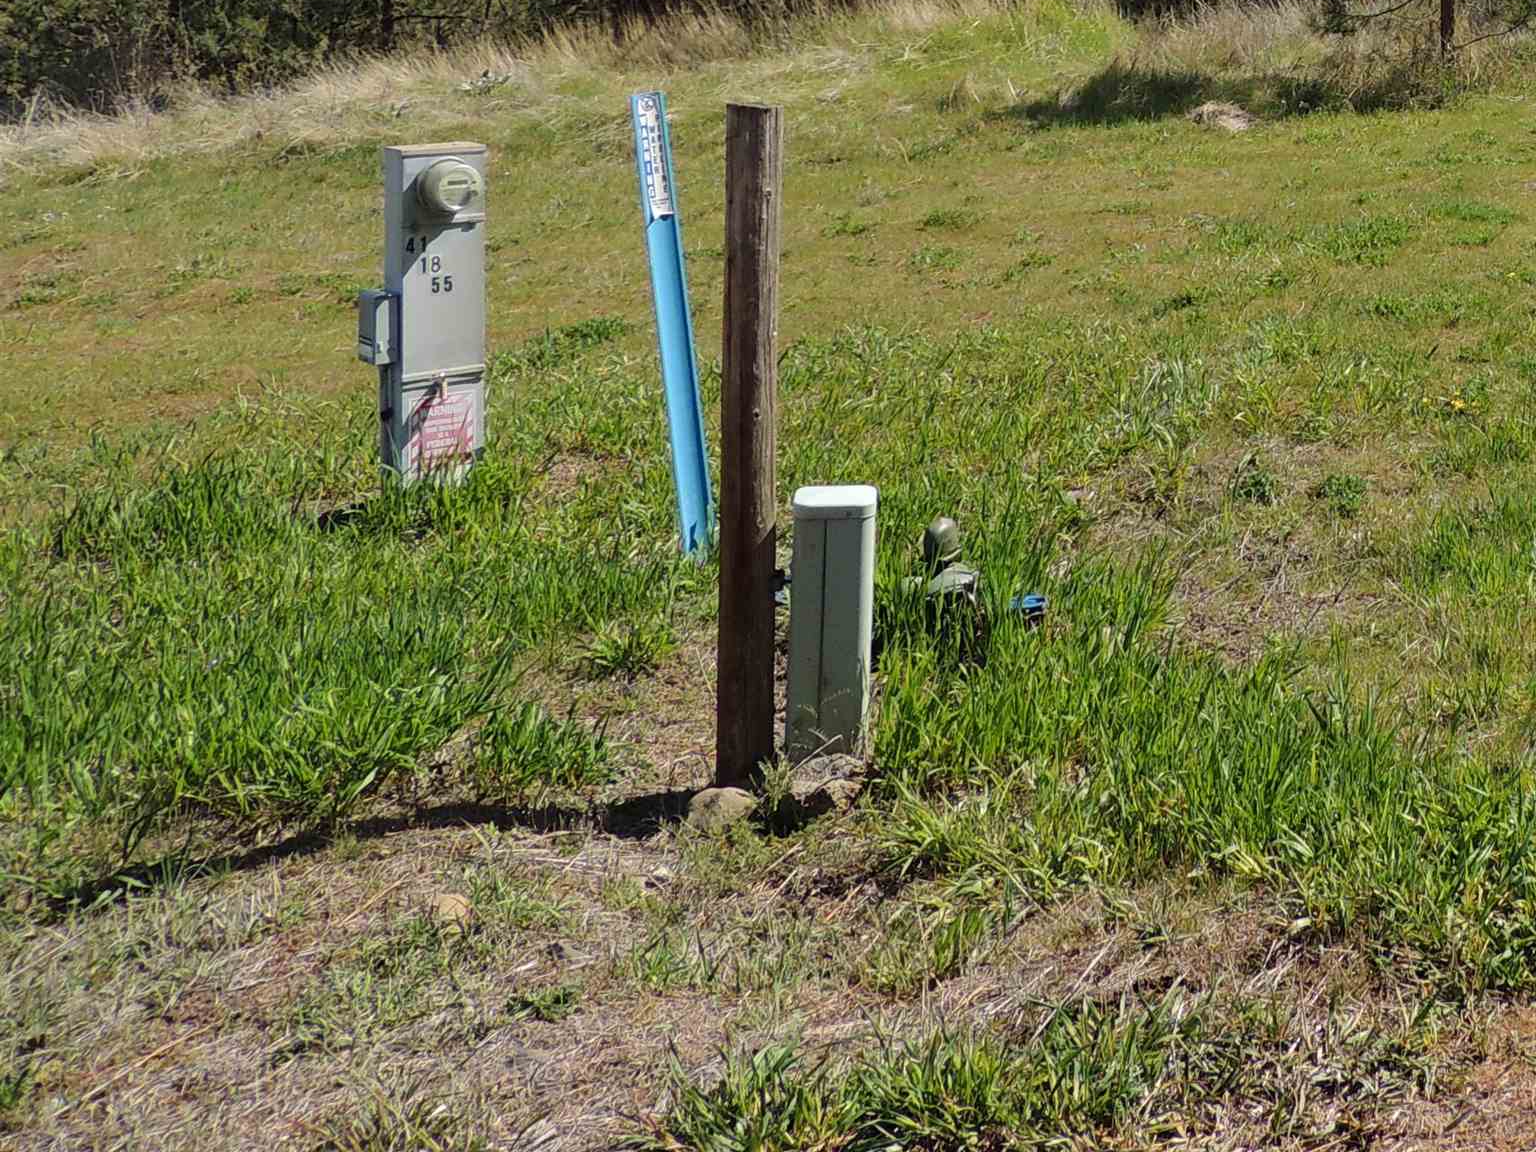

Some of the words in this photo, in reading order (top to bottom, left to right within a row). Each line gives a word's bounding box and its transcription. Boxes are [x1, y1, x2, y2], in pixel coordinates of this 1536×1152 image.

[405, 235, 427, 254] 41
[420, 255, 441, 273] 18
[431, 276, 453, 294] 55
